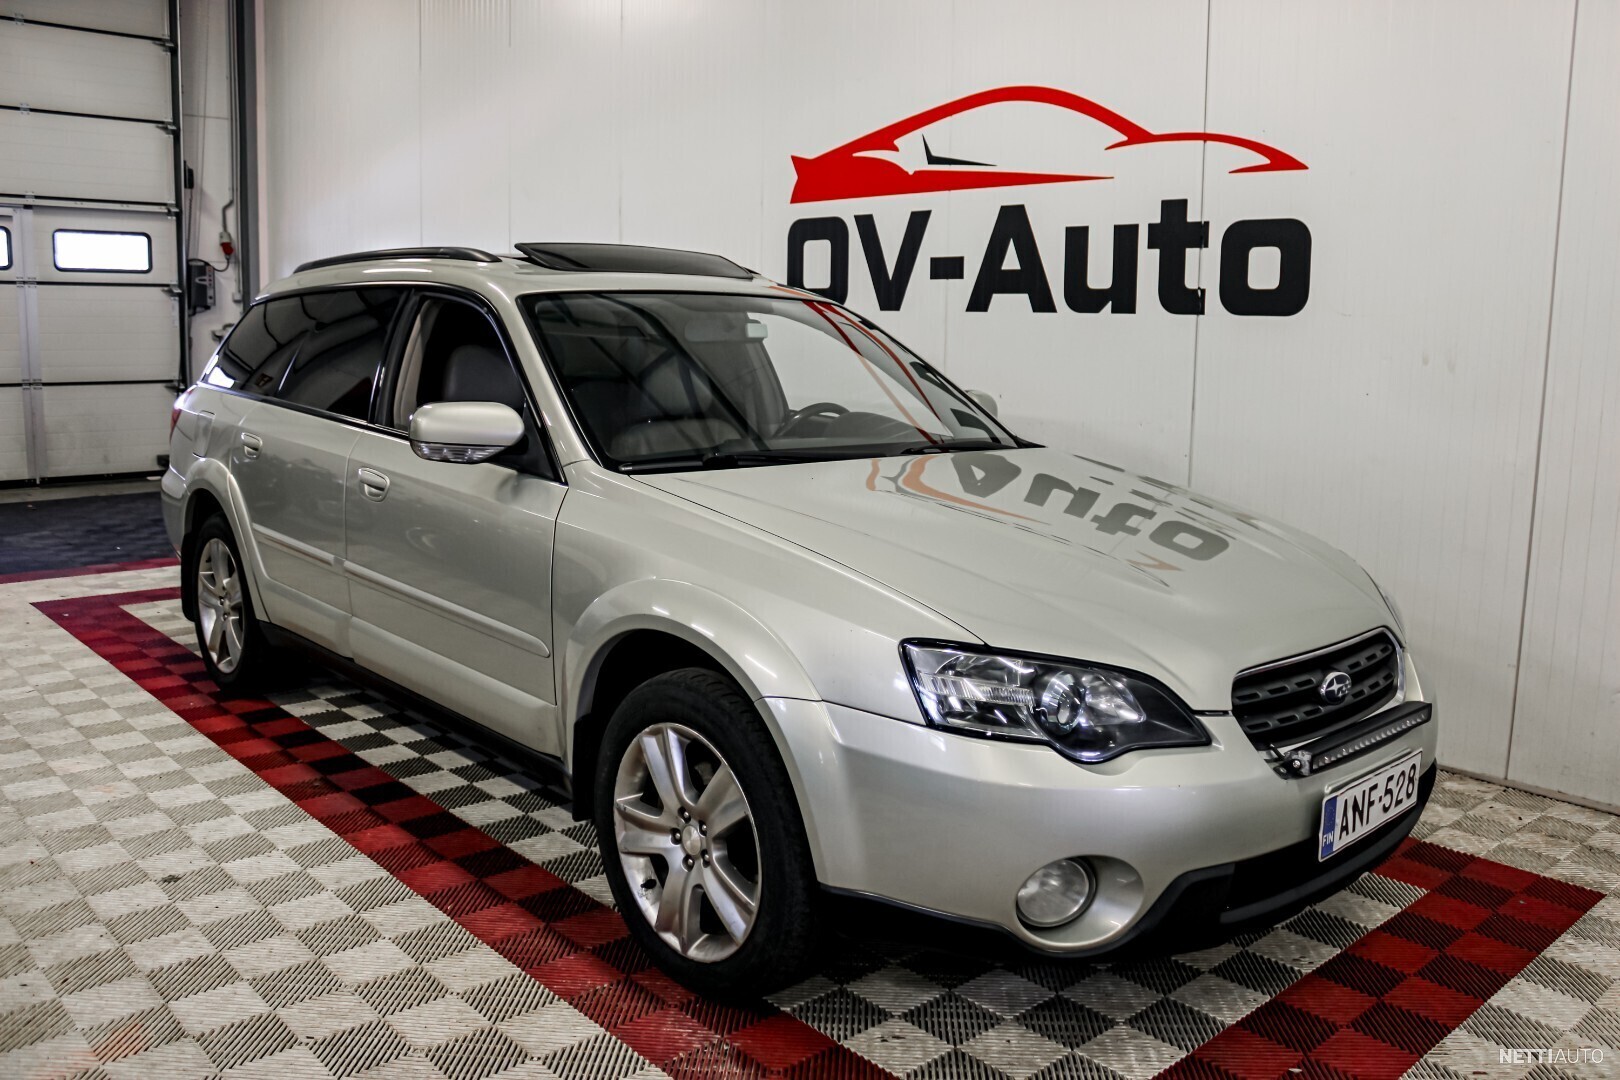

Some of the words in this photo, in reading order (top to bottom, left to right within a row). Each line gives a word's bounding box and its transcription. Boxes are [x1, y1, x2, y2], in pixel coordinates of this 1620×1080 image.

[787, 198, 1312, 317] OV-Auto
[1322, 831, 1334, 848] FIN
[1338, 762, 1417, 841] ANF-528
